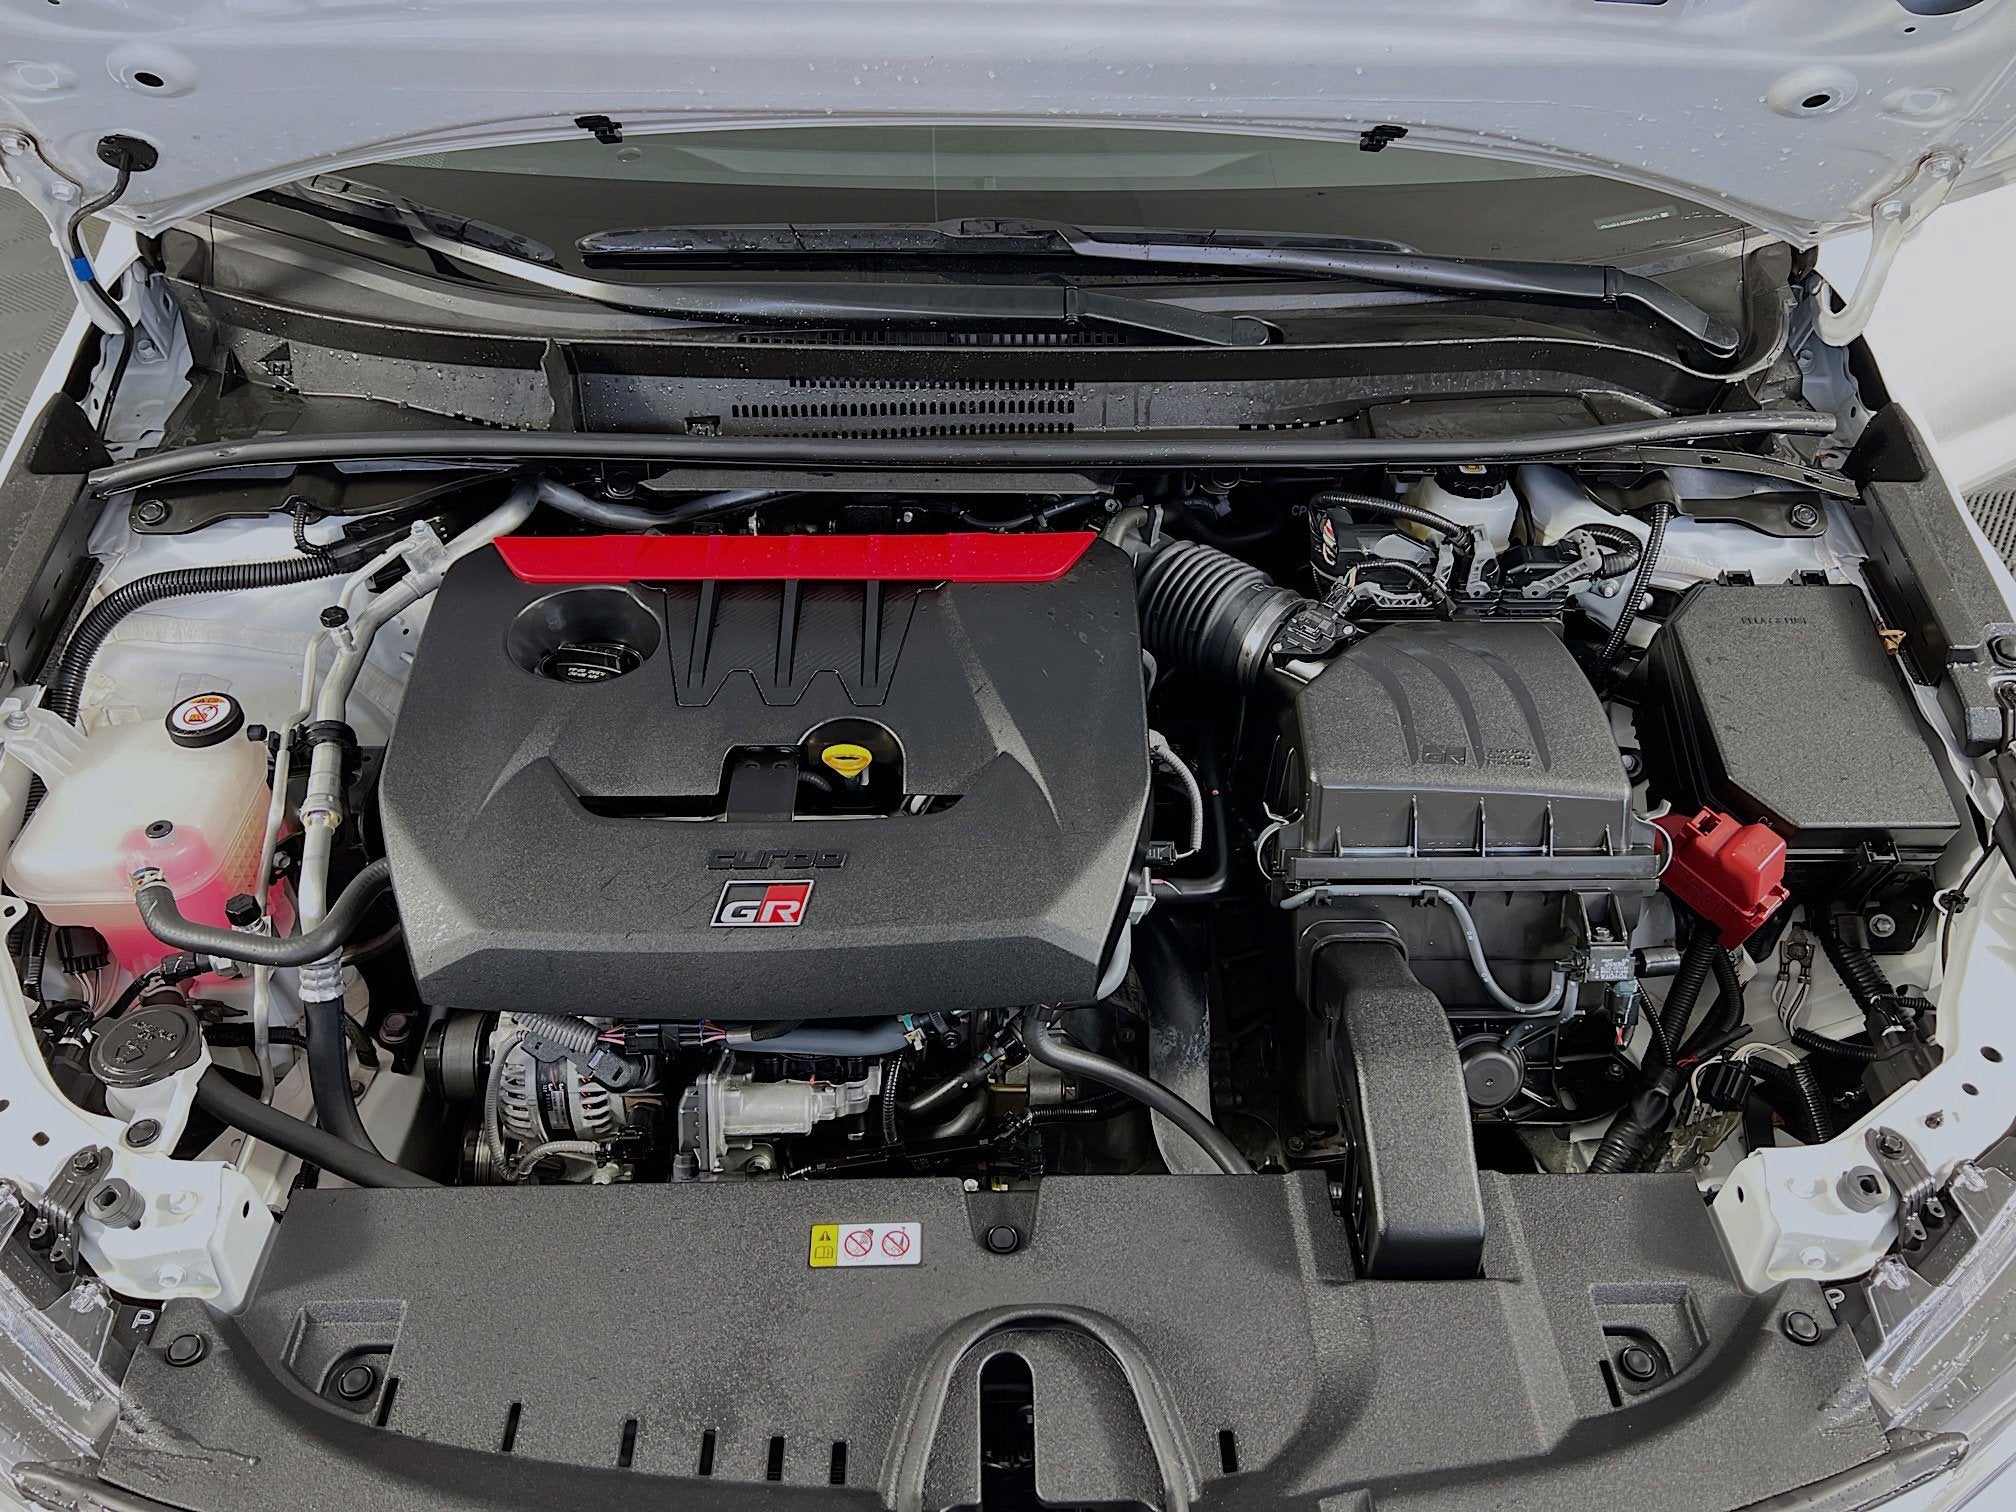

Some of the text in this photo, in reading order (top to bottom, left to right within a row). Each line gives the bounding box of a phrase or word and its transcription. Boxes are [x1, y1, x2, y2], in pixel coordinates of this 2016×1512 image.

[720, 900, 801, 923] GR
[1825, 1288, 1845, 1310] P
[131, 1309, 155, 1329] P
